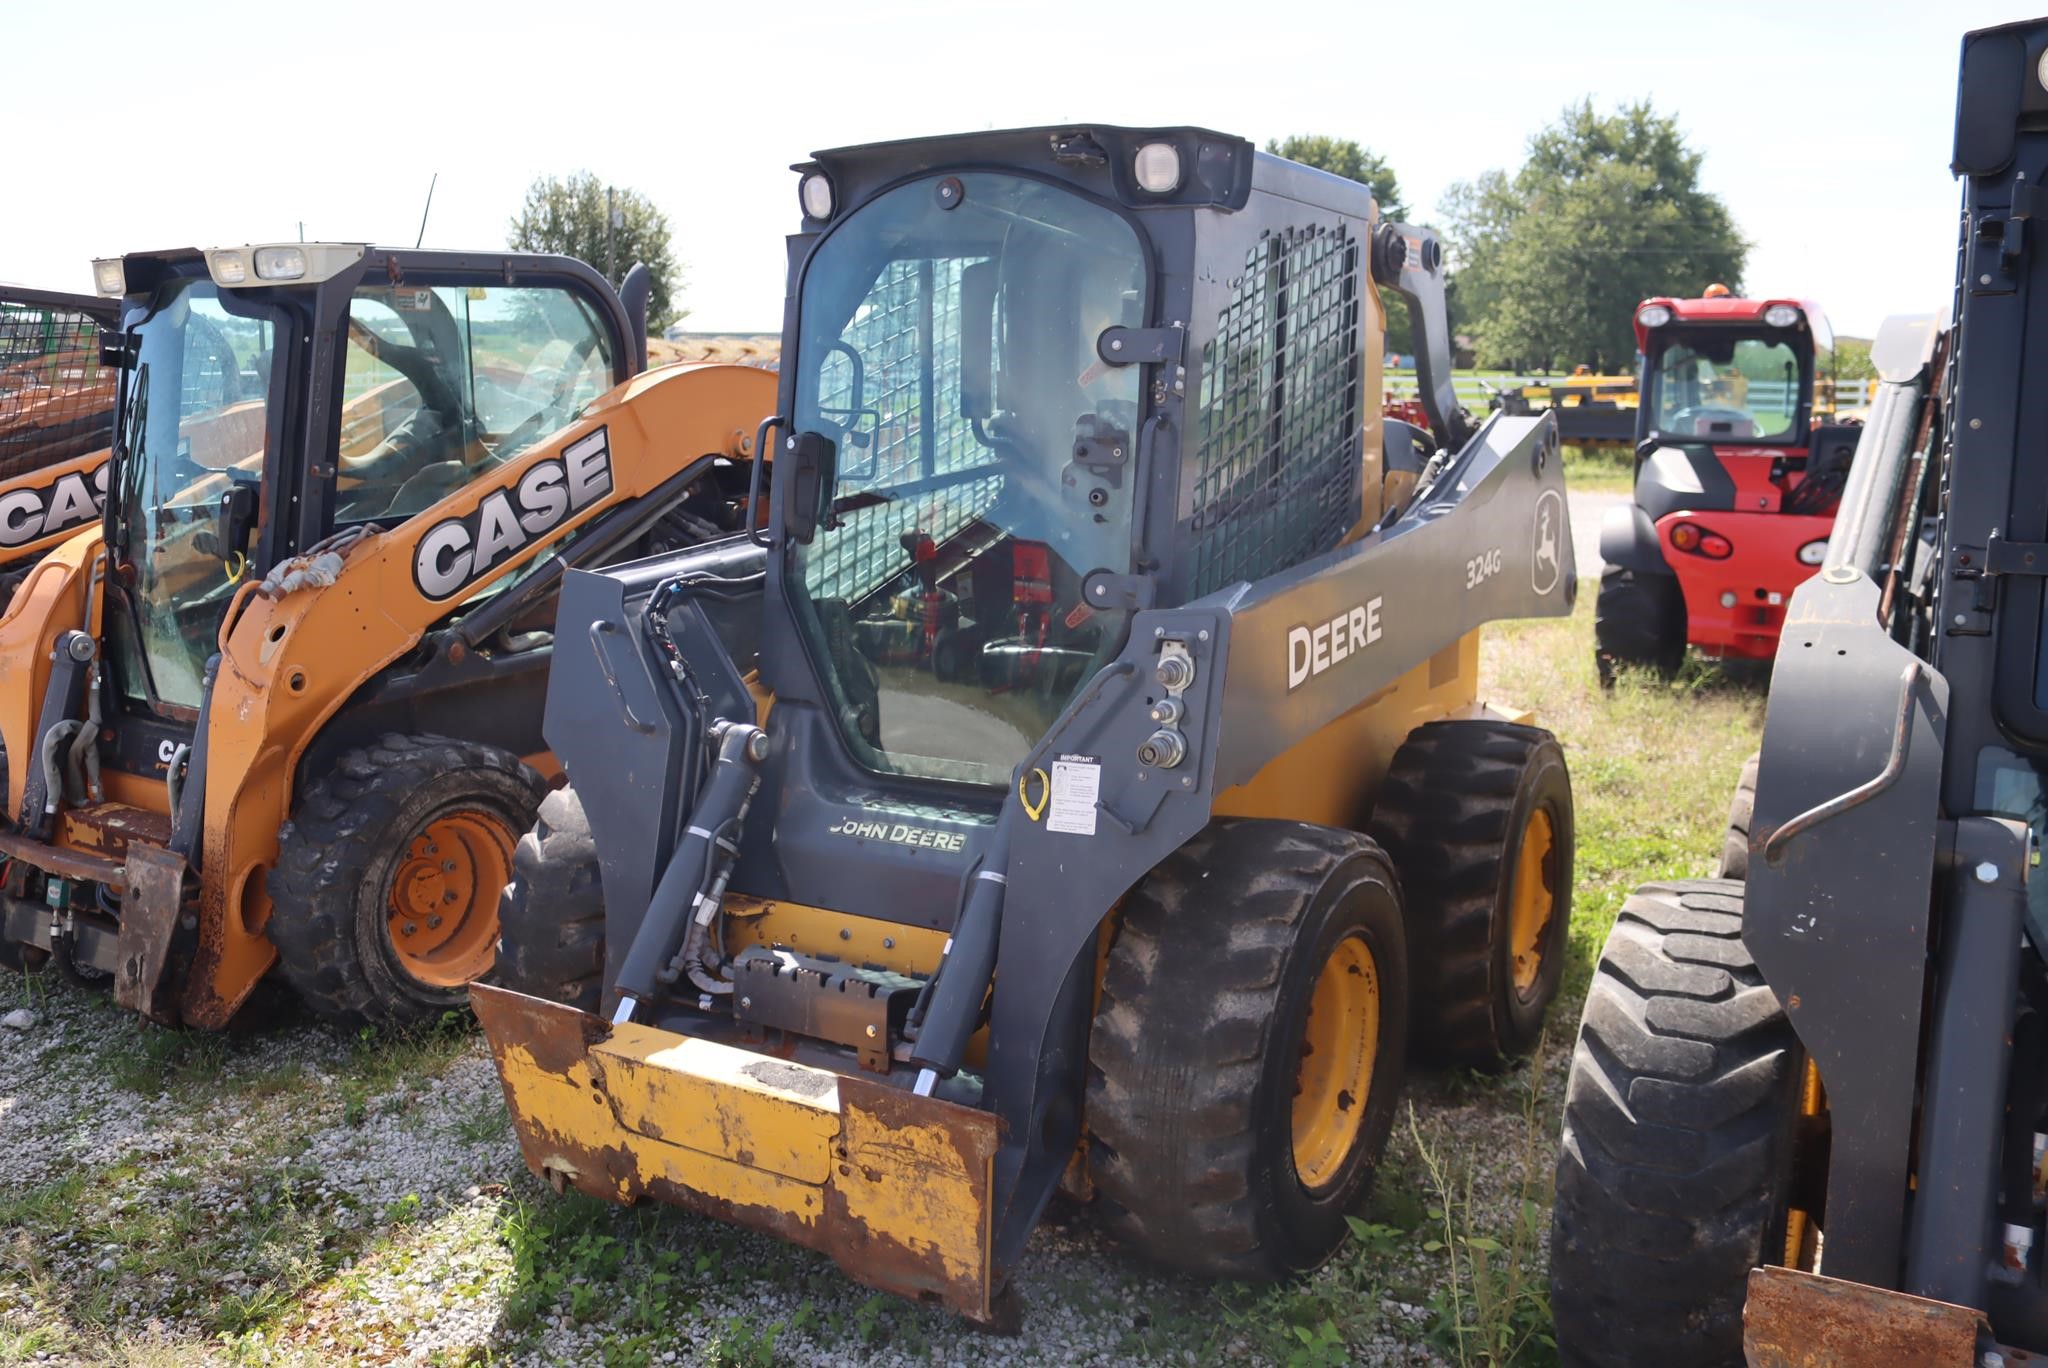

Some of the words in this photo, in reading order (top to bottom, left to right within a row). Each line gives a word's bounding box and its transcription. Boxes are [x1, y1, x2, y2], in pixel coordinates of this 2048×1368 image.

[0, 464, 108, 545] CA
[416, 428, 612, 597] CASE
[1466, 549, 1501, 590] 324G
[1288, 596, 1382, 689] DEERE
[1060, 754, 1094, 763] IMPORTANT
[889, 824, 964, 851] DEERE
